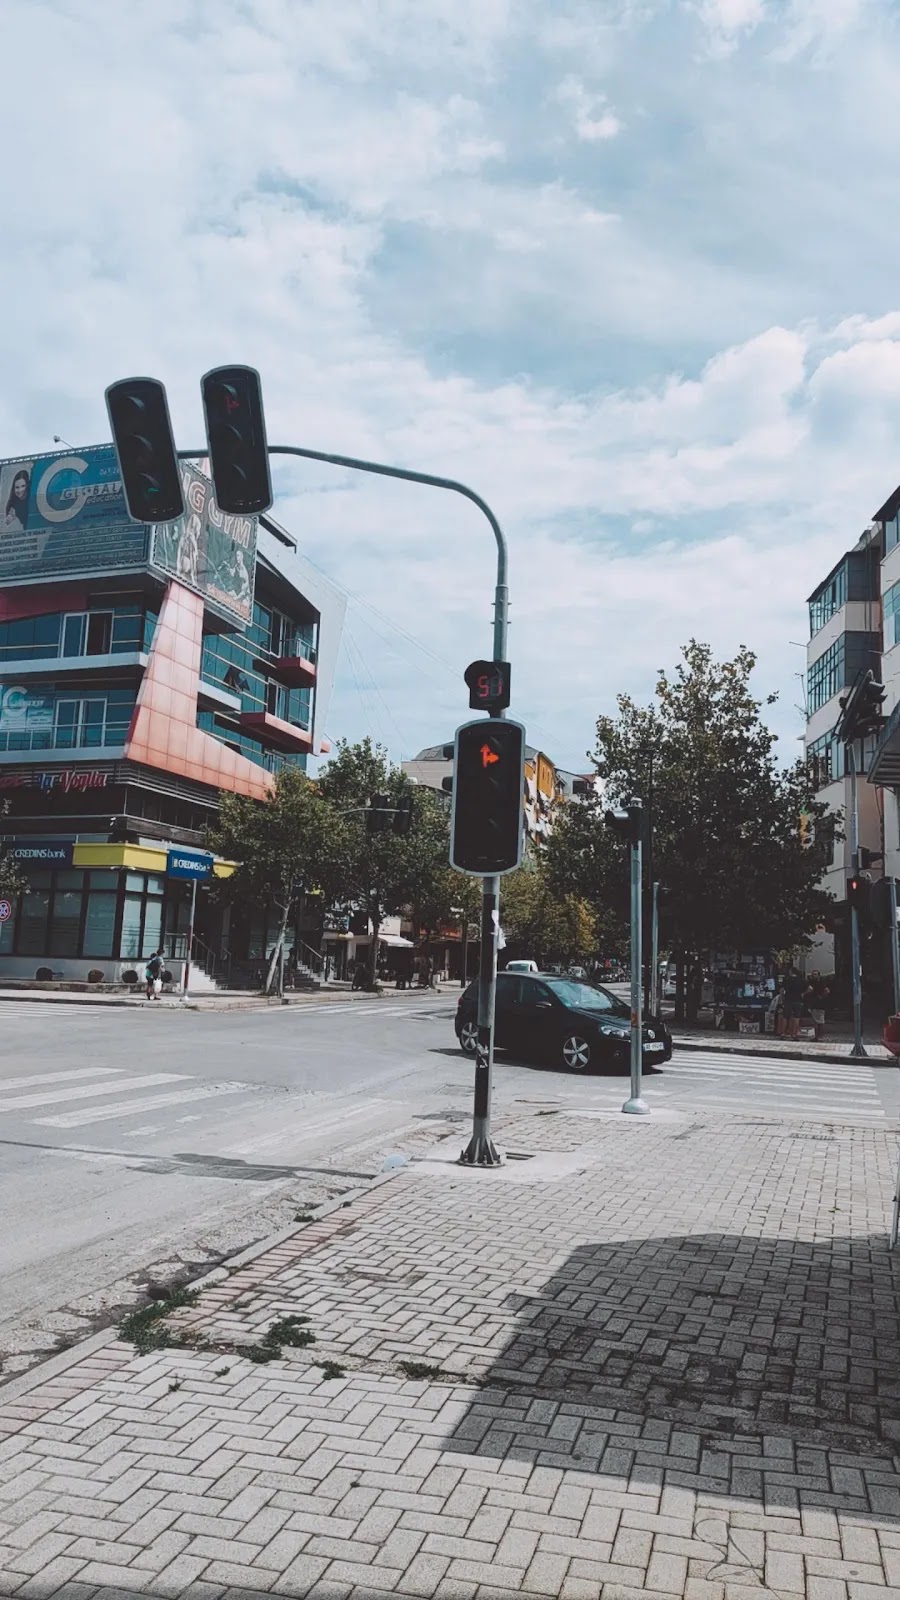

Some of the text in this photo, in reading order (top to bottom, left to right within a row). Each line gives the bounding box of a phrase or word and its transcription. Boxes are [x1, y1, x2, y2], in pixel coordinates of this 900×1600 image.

[86, 493, 123, 504] education
[208, 497, 251, 548] GYM
[15, 848, 66, 859] CREDINS bank
[178, 859, 200, 871] CREDINS
